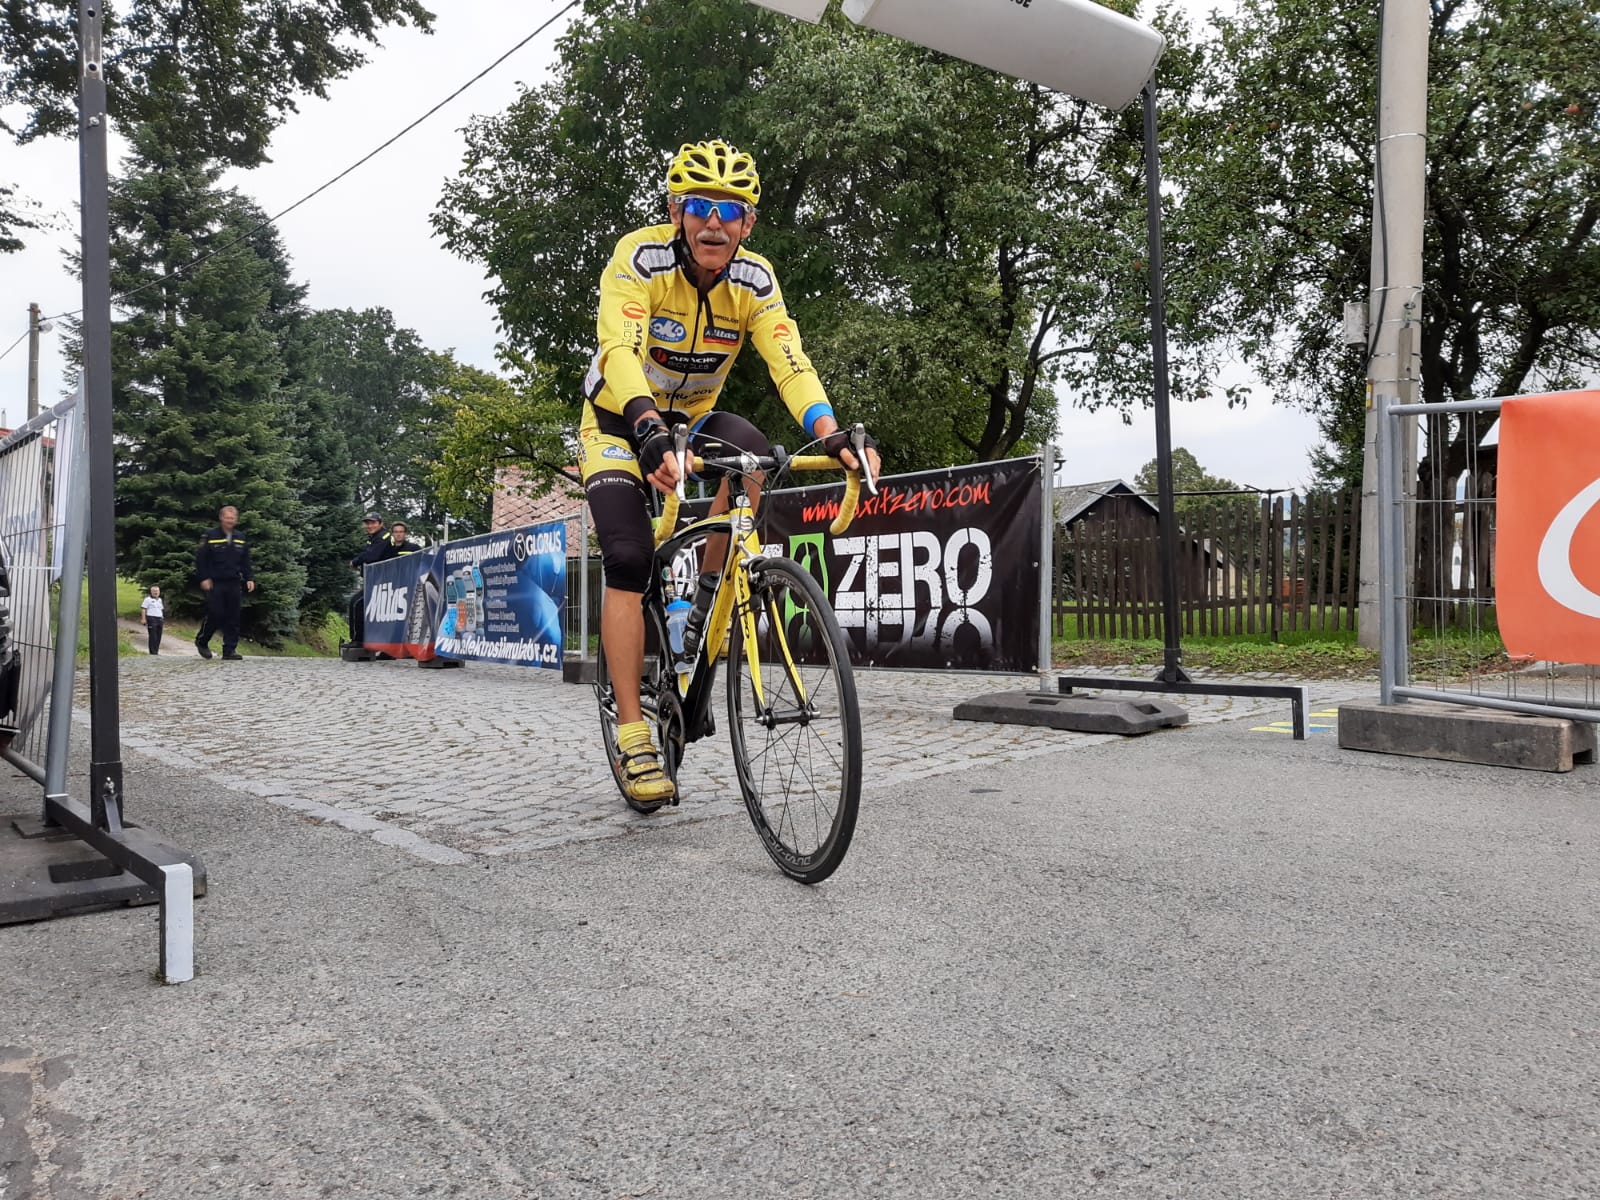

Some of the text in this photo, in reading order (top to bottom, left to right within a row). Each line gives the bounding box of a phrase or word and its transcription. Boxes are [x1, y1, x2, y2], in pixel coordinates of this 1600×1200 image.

[802, 482, 991, 523] wwwxitzero.com
[526, 531, 562, 556] GLOBUS
[832, 527, 993, 610] ZERO
[365, 582, 408, 622] Mitas
